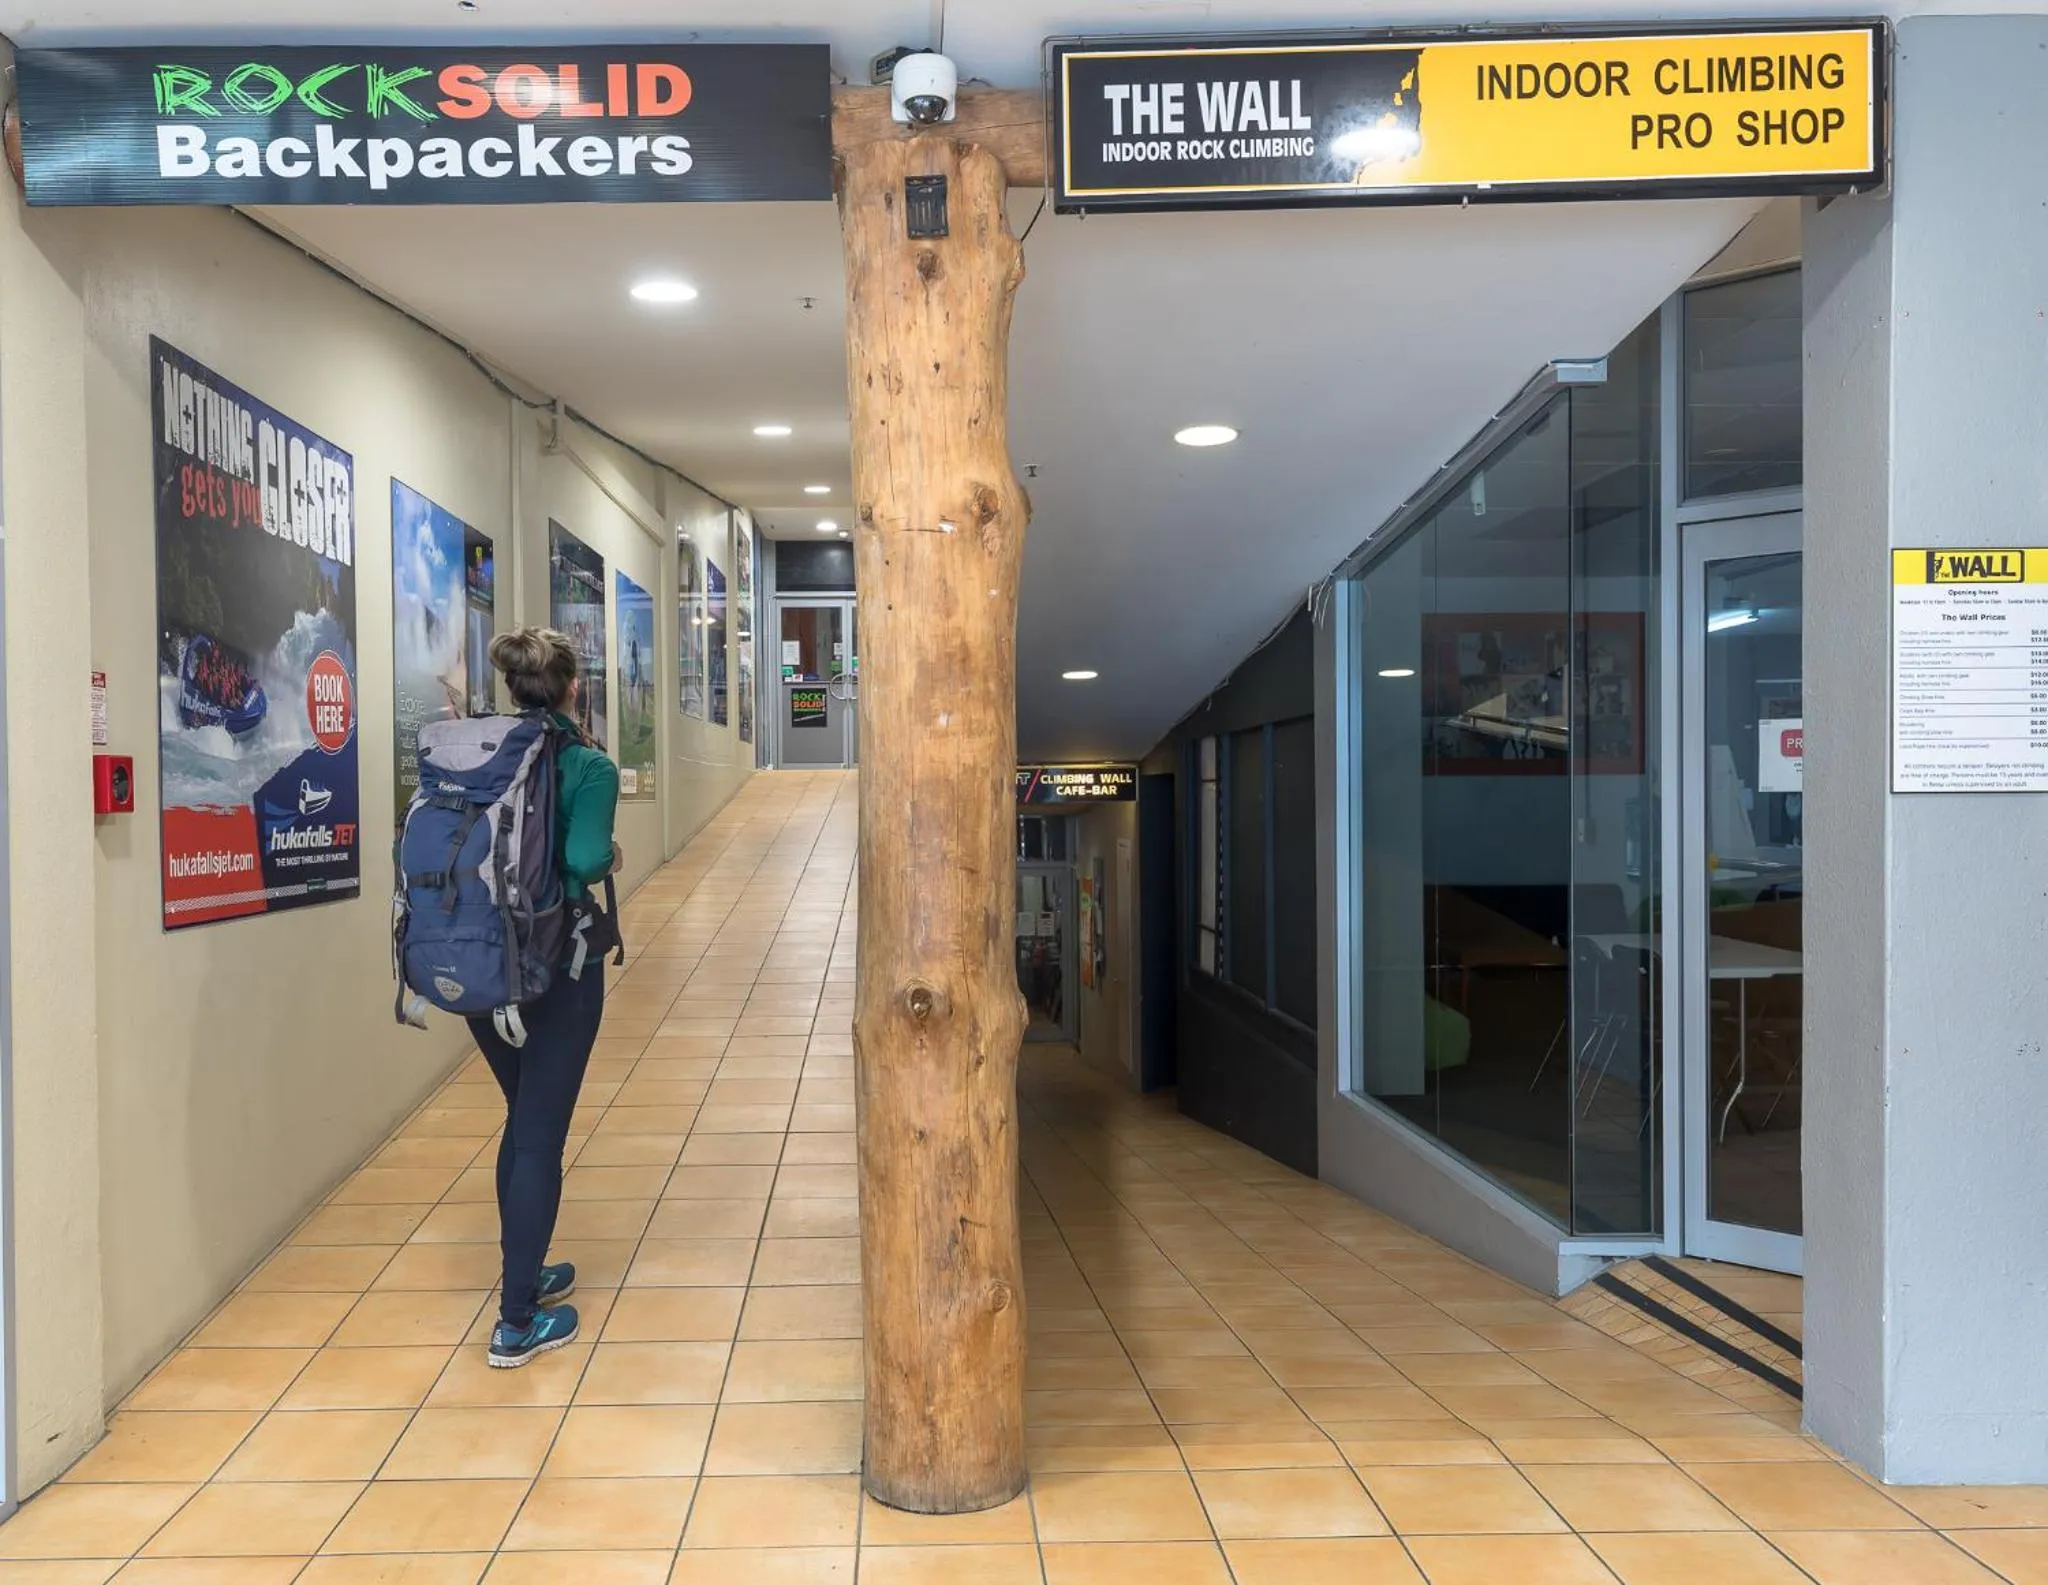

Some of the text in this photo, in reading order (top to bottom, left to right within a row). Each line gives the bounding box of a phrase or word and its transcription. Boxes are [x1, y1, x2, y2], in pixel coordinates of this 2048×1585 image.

[1477, 53, 1844, 100] INDOOR CLIMBING
[1104, 79, 1312, 135] THE WALL
[1632, 107, 1844, 150] PRO SHOP
[156, 124, 693, 190] Backpackers
[1103, 137, 1314, 162] INDOOR ROCK CLIMBING
[163, 360, 254, 484] NOTHING
[181, 463, 262, 528] gets you
[258, 418, 351, 566] CLOSER
[1949, 555, 2016, 578] WALL
[314, 674, 344, 702] BOOK
[316, 705, 344, 732] HERE
[1040, 773, 1095, 785] CLIMBING
[1100, 773, 1132, 783] WALL
[1056, 785, 1117, 796] CAFE-BAR
[169, 850, 254, 878] hukafallsjet.com
